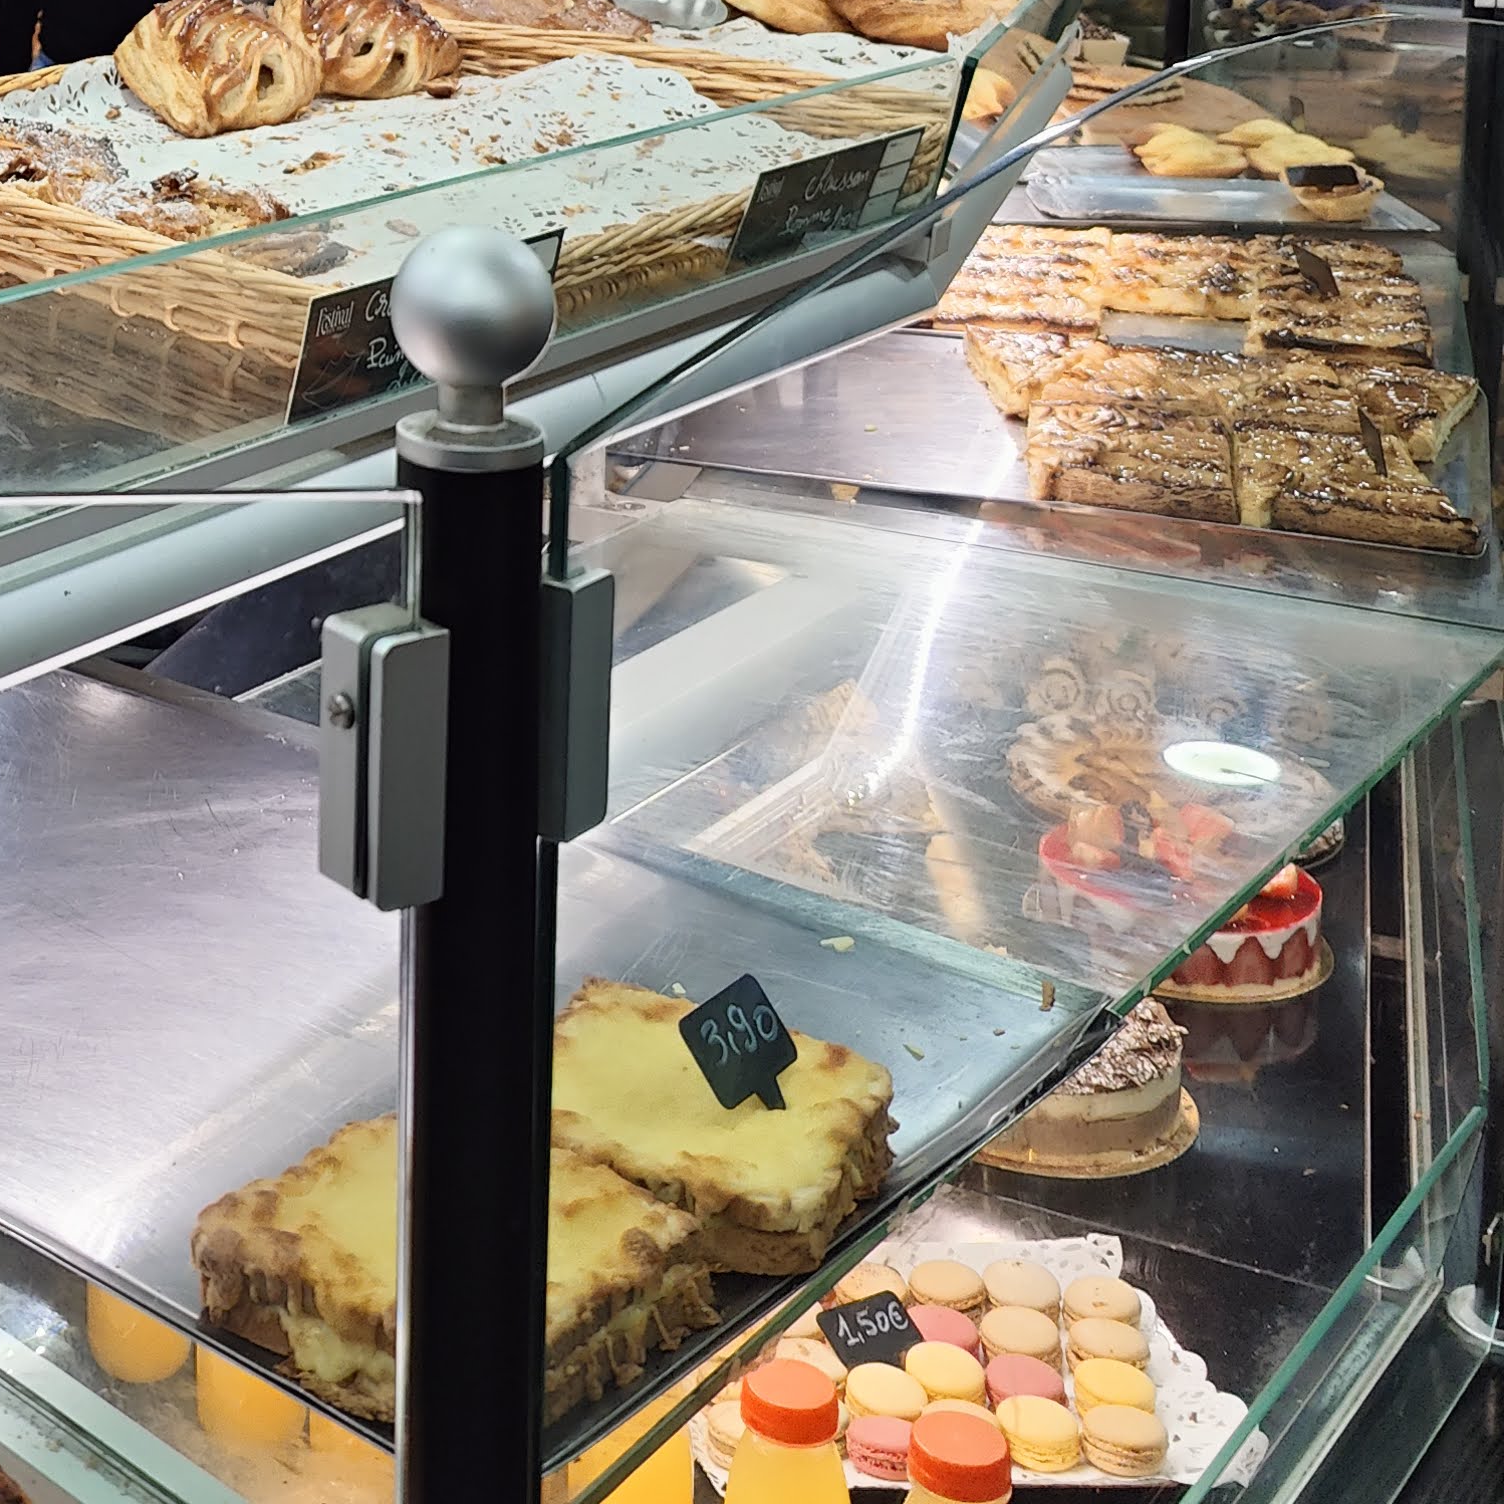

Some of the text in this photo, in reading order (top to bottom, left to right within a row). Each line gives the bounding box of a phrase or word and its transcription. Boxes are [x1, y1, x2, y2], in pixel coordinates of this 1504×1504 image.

[316, 299, 355, 338] Festival
[700, 1003, 778, 1066] 3,90
[837, 1300, 909, 1347] 1,50€
